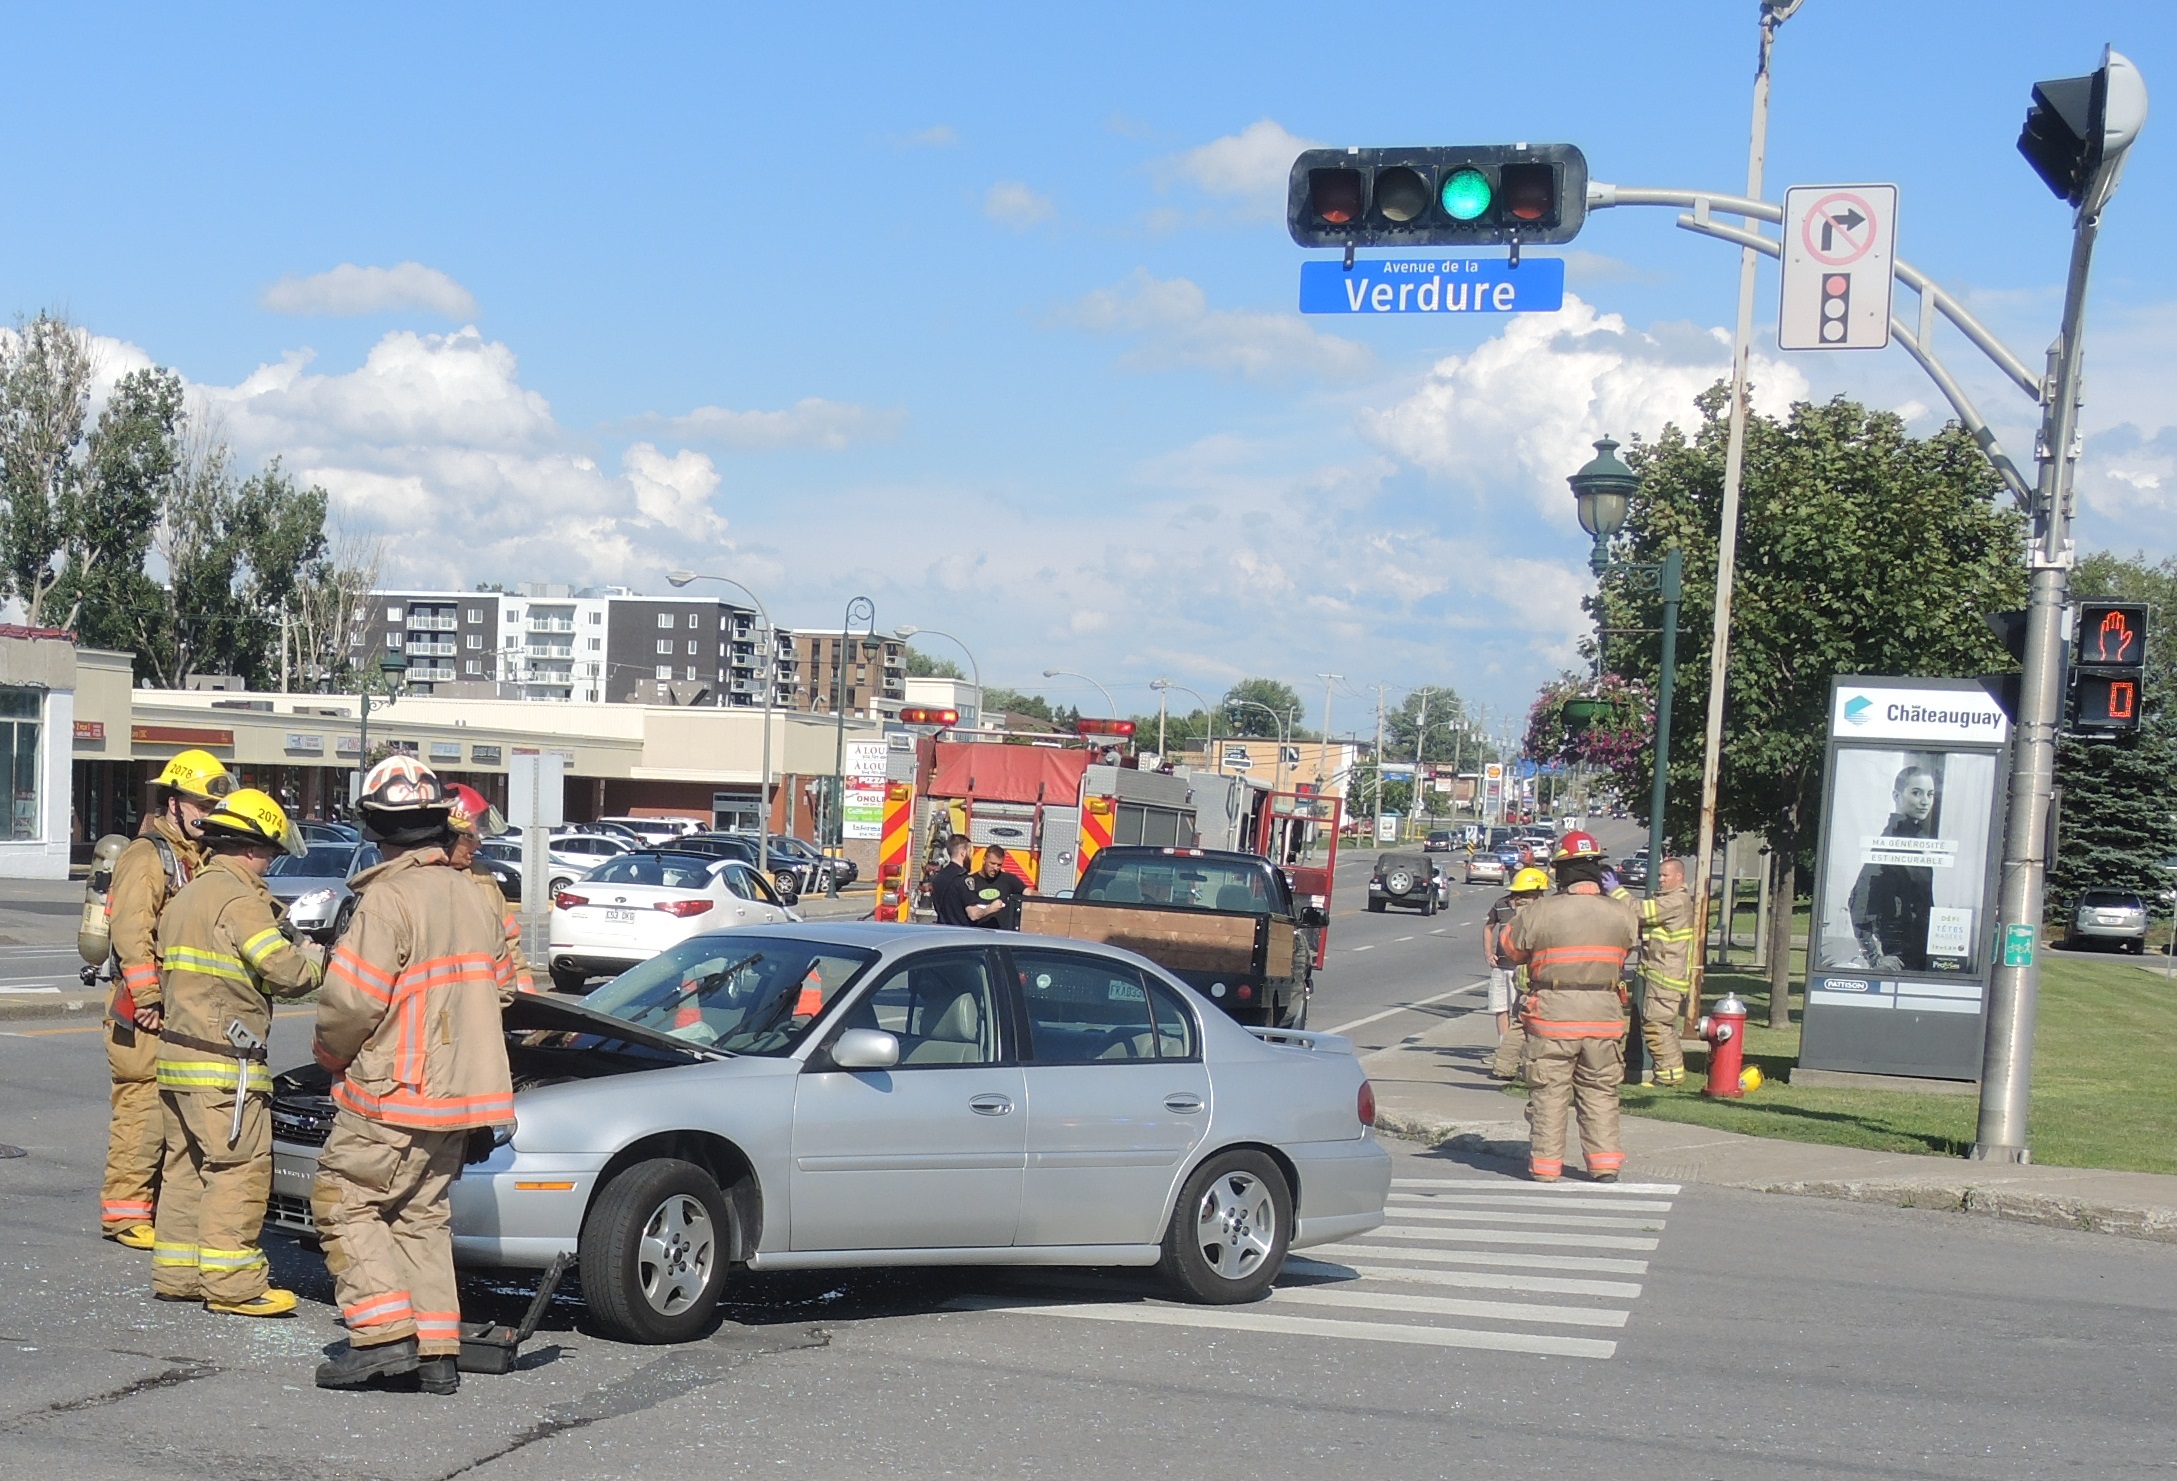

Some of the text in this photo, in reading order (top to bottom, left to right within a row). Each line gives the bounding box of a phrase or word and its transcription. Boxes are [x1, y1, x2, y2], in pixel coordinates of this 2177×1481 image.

[1383, 260, 1479, 273] Avenue de la
[1344, 275, 1516, 312] Verdure
[1887, 704, 2003, 730] Châteauguay
[864, 746, 888, 755] LOU
[169, 763, 194, 779] 2078
[863, 762, 886, 771] LOU
[257, 807, 284, 829] 2074
[1871, 854, 1944, 865] EST INCURABLE
[1827, 980, 1865, 989] PATTISON
